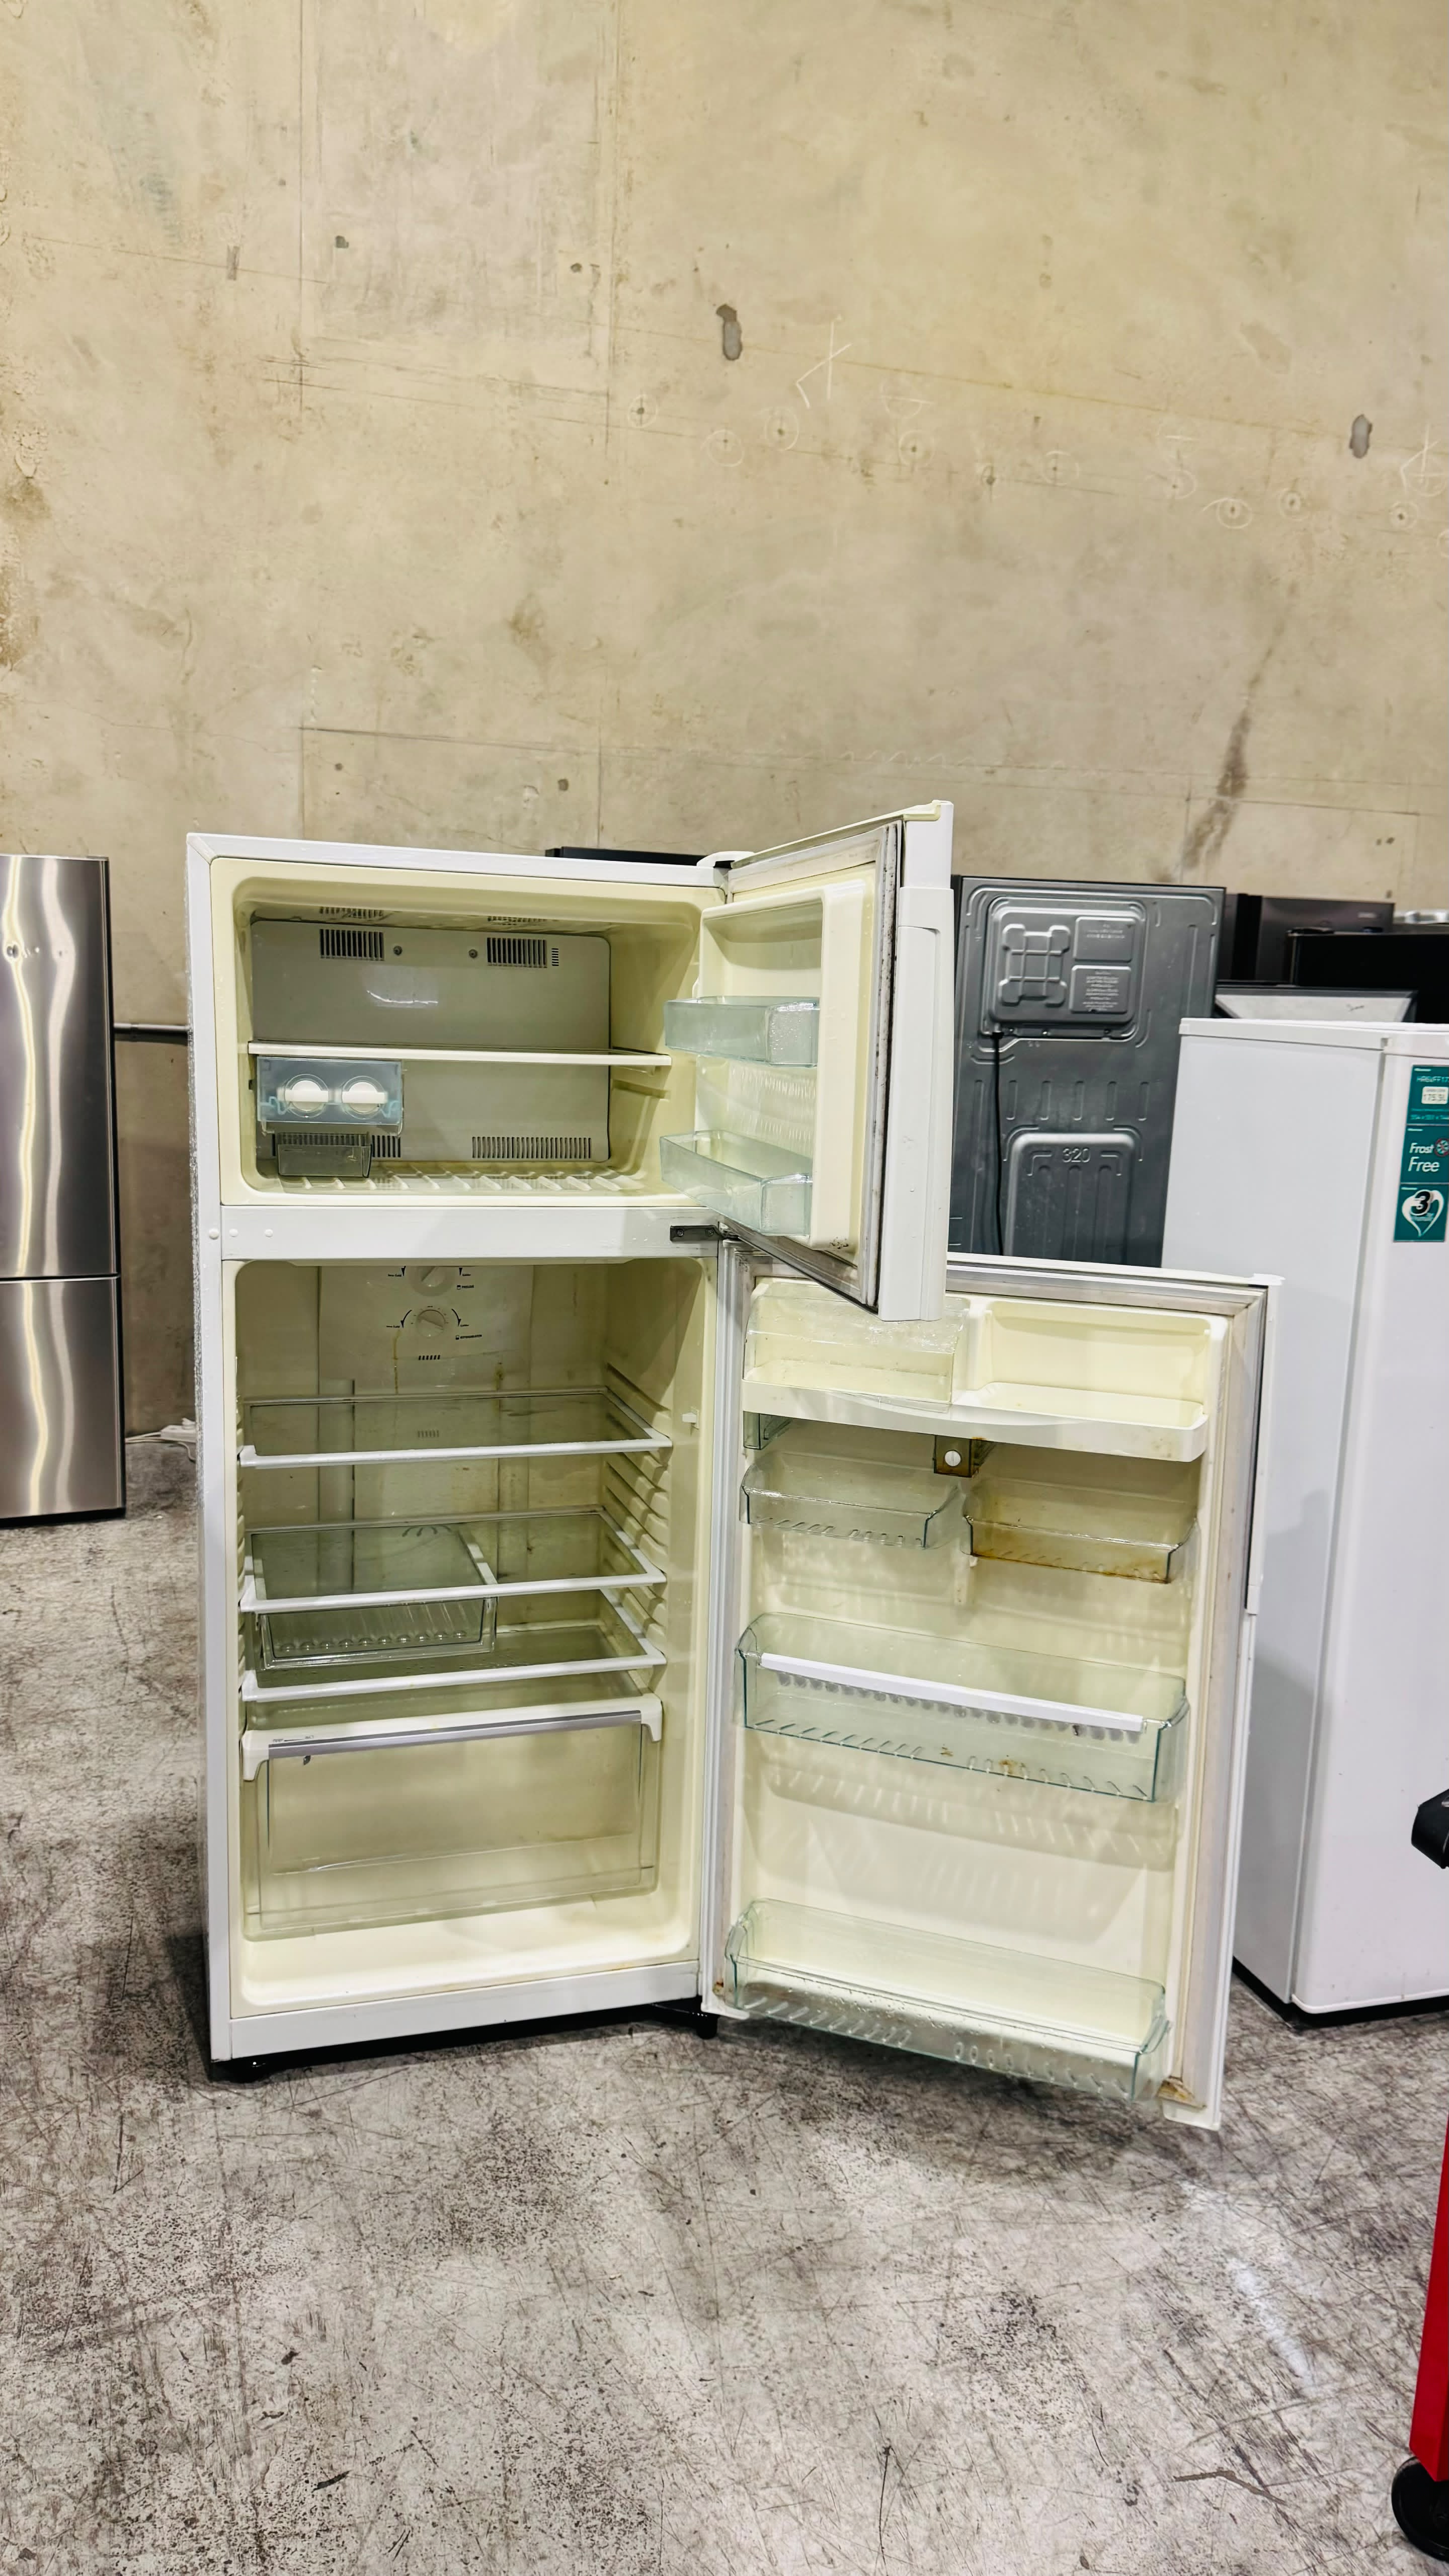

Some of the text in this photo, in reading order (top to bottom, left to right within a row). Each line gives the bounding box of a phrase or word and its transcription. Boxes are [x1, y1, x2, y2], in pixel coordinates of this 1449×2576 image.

[1062, 1148, 1091, 1163] 320
[1409, 1142, 1434, 1154] Frost
[1408, 1156, 1440, 1172] Free
[1411, 1190, 1431, 1215] 3
